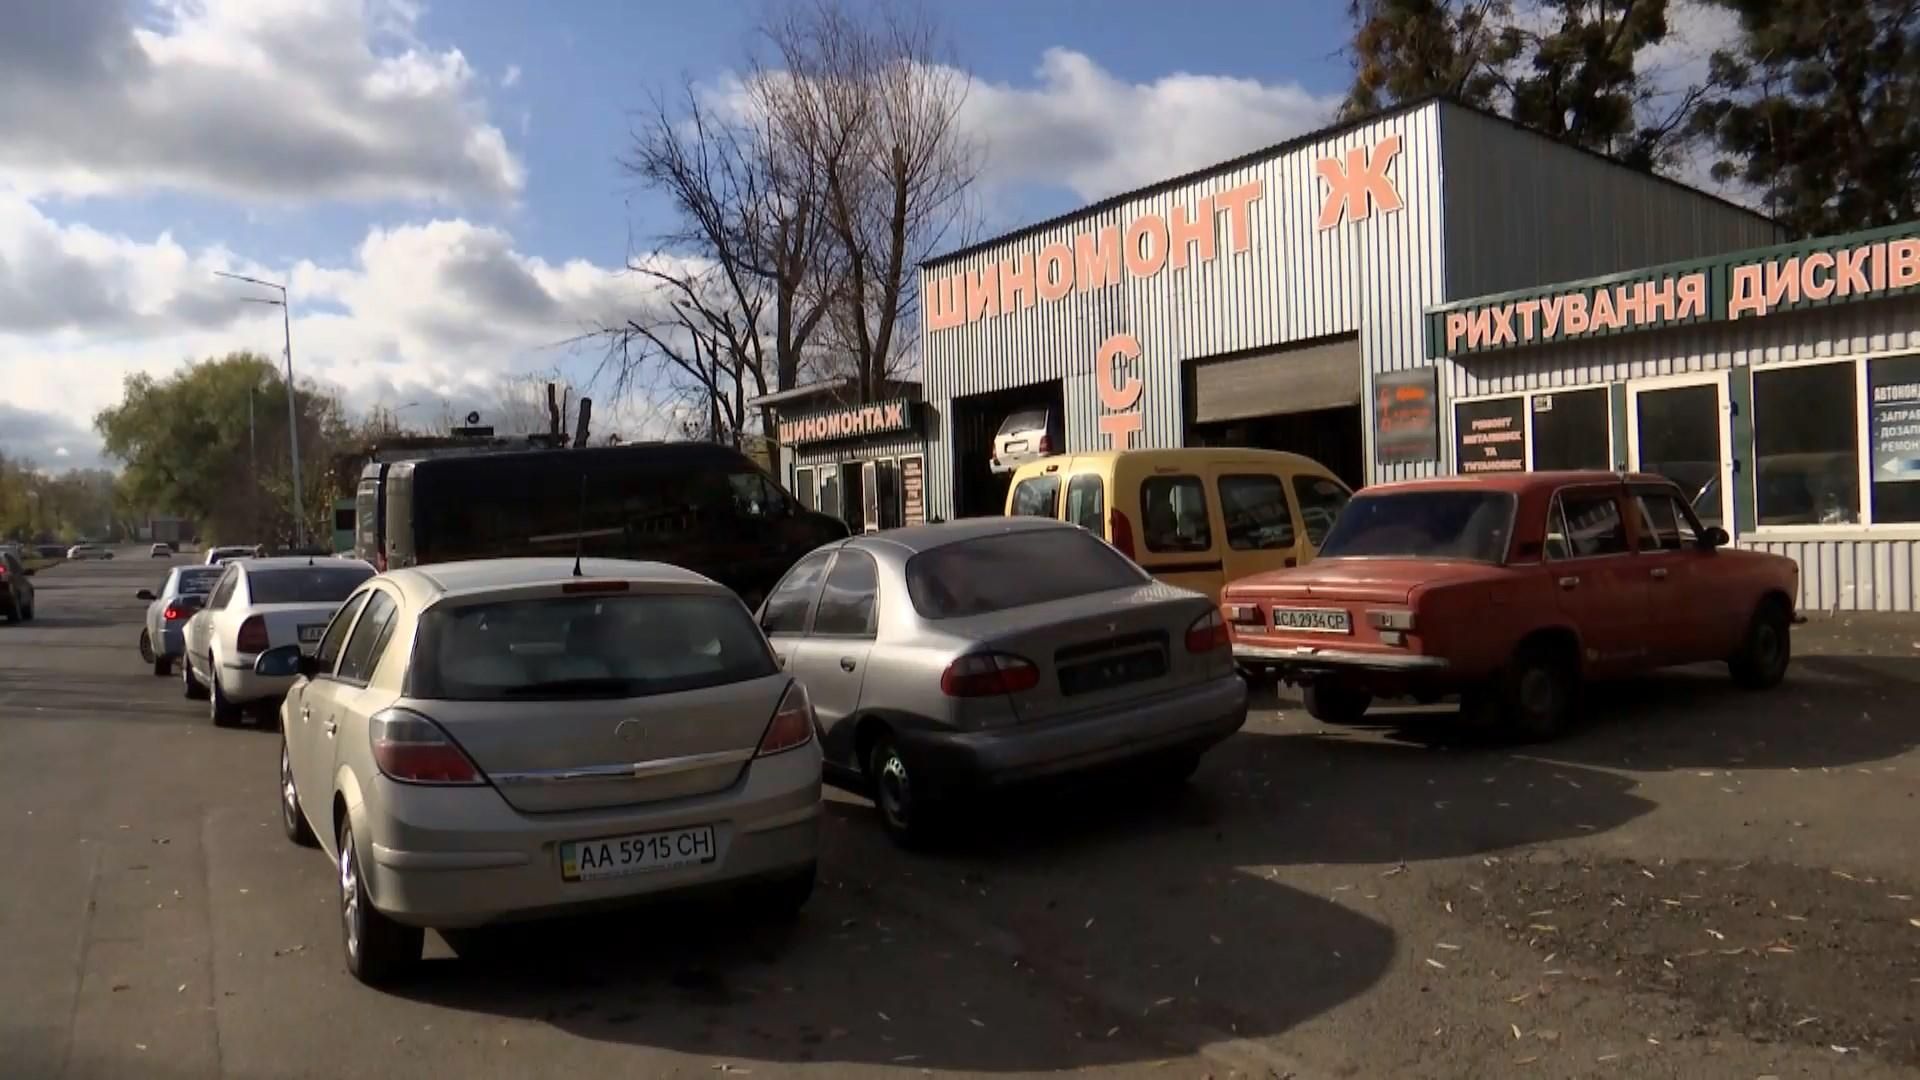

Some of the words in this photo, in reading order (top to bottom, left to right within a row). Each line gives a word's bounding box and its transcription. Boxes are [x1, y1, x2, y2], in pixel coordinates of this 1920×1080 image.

[1315, 133, 1404, 232] Ж
[1445, 272, 1707, 352] РИХТУВАННЯ
[1728, 238, 1920, 321] ДИСКІВ
[779, 402, 904, 444] ШИНОМОНТАЖ
[1484, 447, 1498, 458] ТА
[1299, 613, 1326, 628] 2934
[581, 844, 614, 870] AA
[620, 835, 671, 865] 5915
[677, 830, 709, 856] CH
